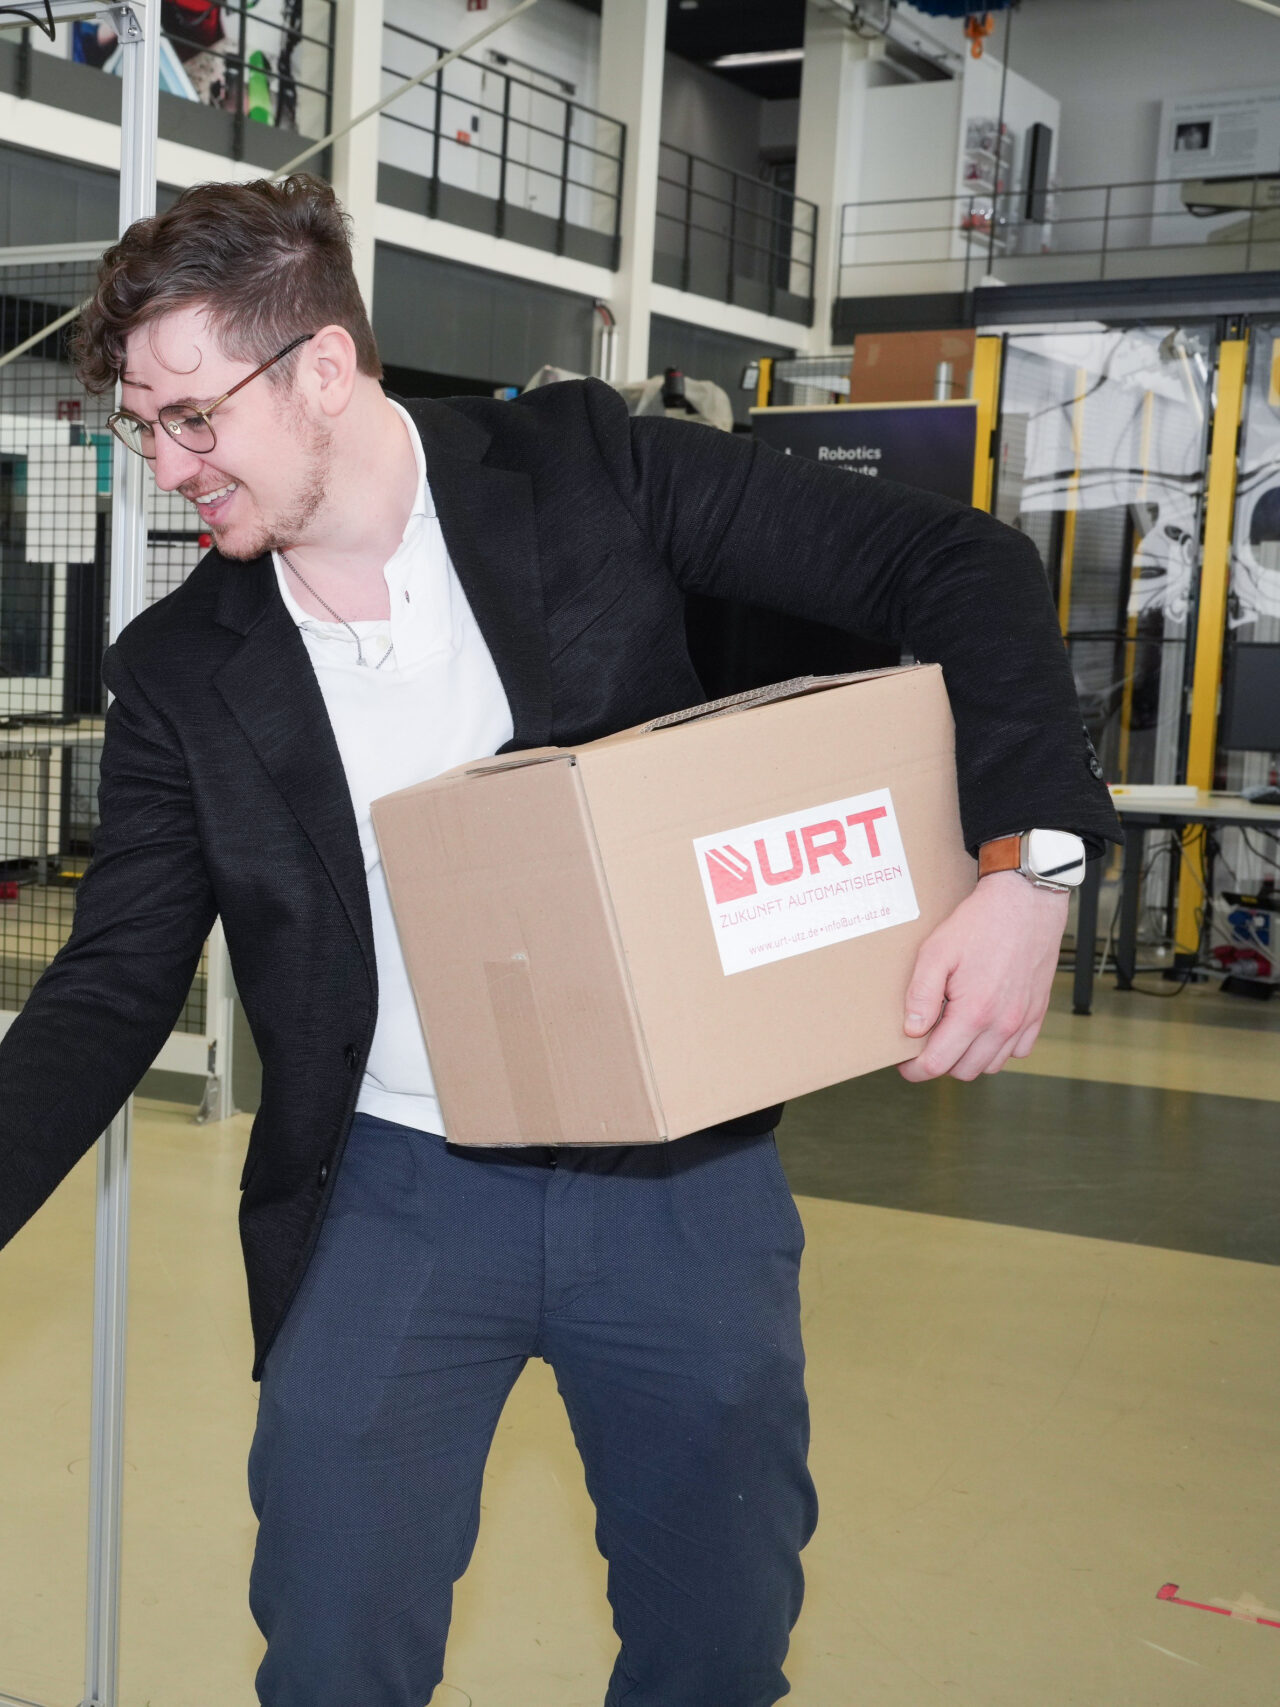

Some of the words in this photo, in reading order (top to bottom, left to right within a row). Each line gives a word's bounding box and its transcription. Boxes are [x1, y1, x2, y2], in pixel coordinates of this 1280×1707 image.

[818, 446, 881, 460] Robotics
[754, 806, 887, 886] URT
[720, 899, 783, 928] ZUKUNFT
[788, 865, 903, 909] AUTOMATISIEREN
[749, 926, 819, 955] www.urt-utz.de
[825, 905, 891, 932] info@urt-utz.de
